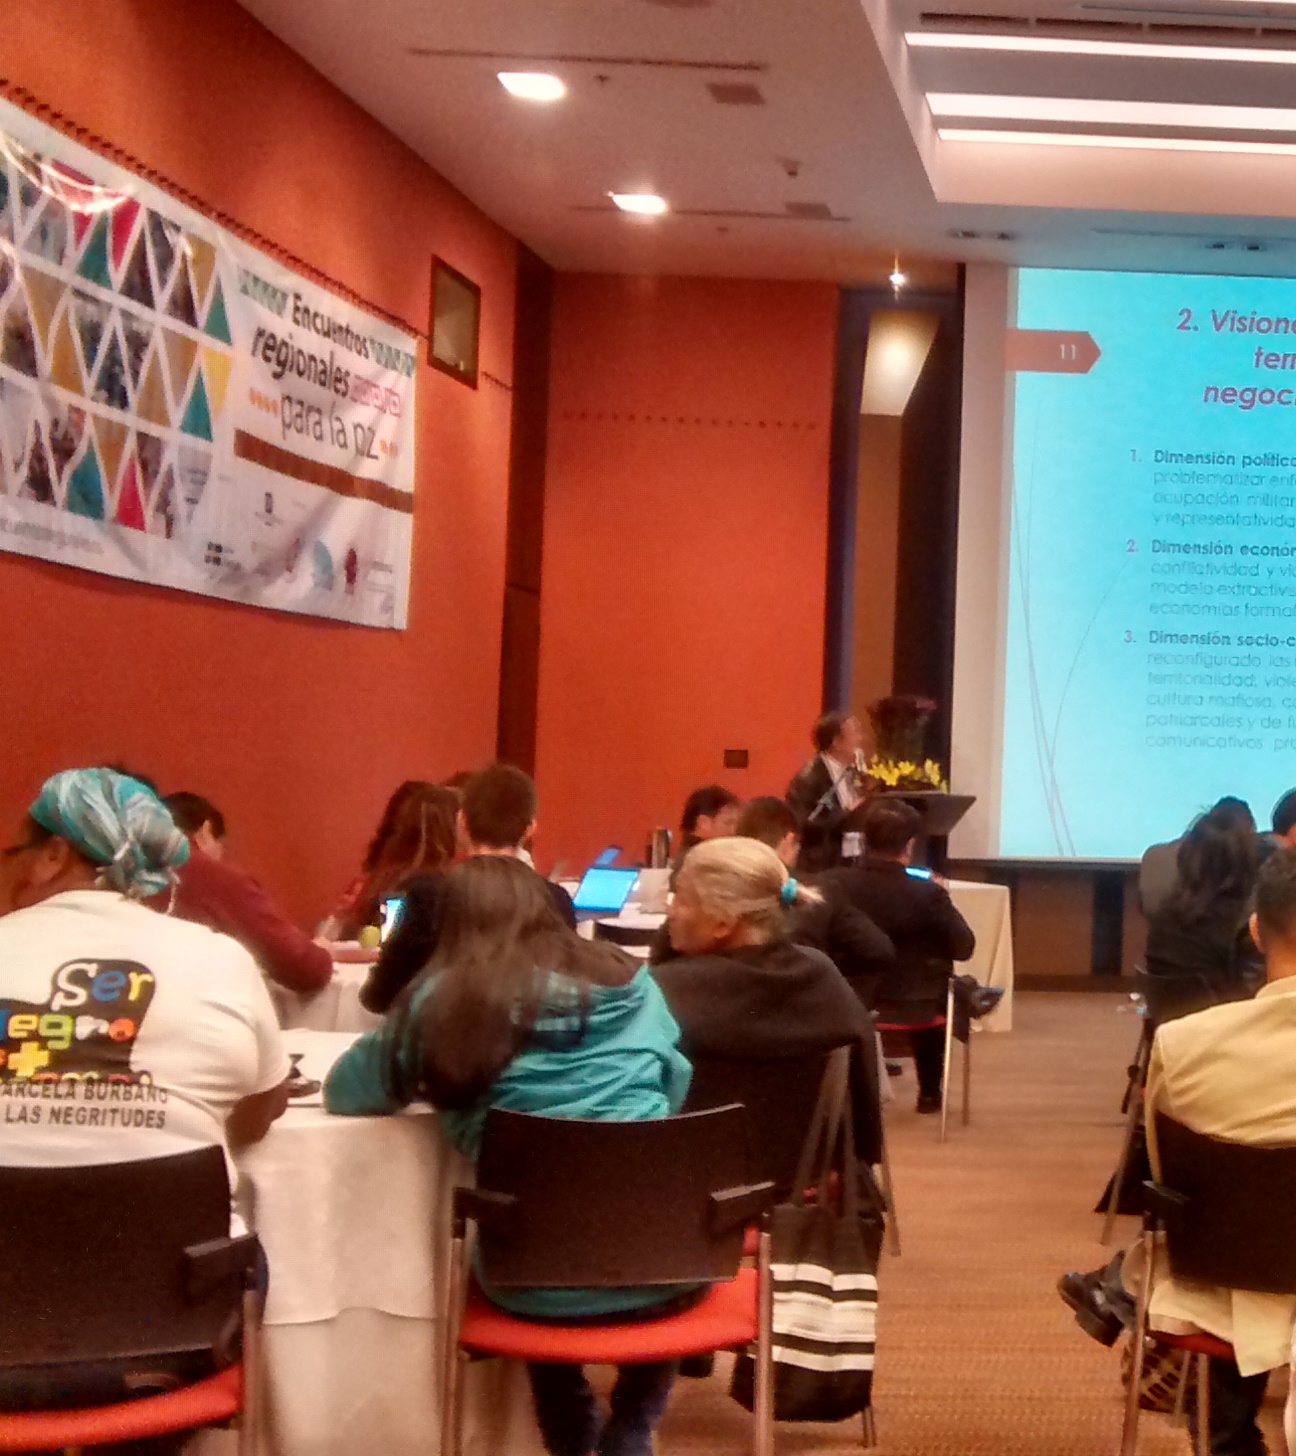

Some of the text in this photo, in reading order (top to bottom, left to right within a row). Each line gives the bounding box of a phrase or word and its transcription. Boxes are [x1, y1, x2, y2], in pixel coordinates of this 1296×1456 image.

[1177, 308, 1199, 332] 2.
[1060, 344, 1076, 360] 11
[251, 326, 351, 398] regionales
[281, 393, 323, 441] para
[329, 401, 348, 449] la
[1154, 450, 1235, 466] Dimensión
[1153, 469, 1265, 486] problematizar
[1153, 490, 1239, 507] ocupación
[1153, 513, 1161, 525] y
[1152, 539, 1233, 555] Dimensión
[1151, 561, 1259, 577] conflictividad
[1266, 566, 1273, 578] y
[1151, 580, 1213, 596] modelo
[1150, 601, 1240, 616] economías
[1124, 631, 1136, 643] 3.
[1149, 630, 1231, 646] Dimensión
[1147, 653, 1261, 669] reconfigurado
[1269, 656, 1290, 668] las
[1146, 693, 1203, 707] cultura
[1146, 713, 1242, 729] patriarcales
[1247, 717, 1255, 730] y
[1260, 716, 1282, 729] de
[1146, 734, 1263, 749] comunicativos
[51, 963, 153, 1011] Ser
[5, 1104, 166, 1129] LAS NEGRITUDES
